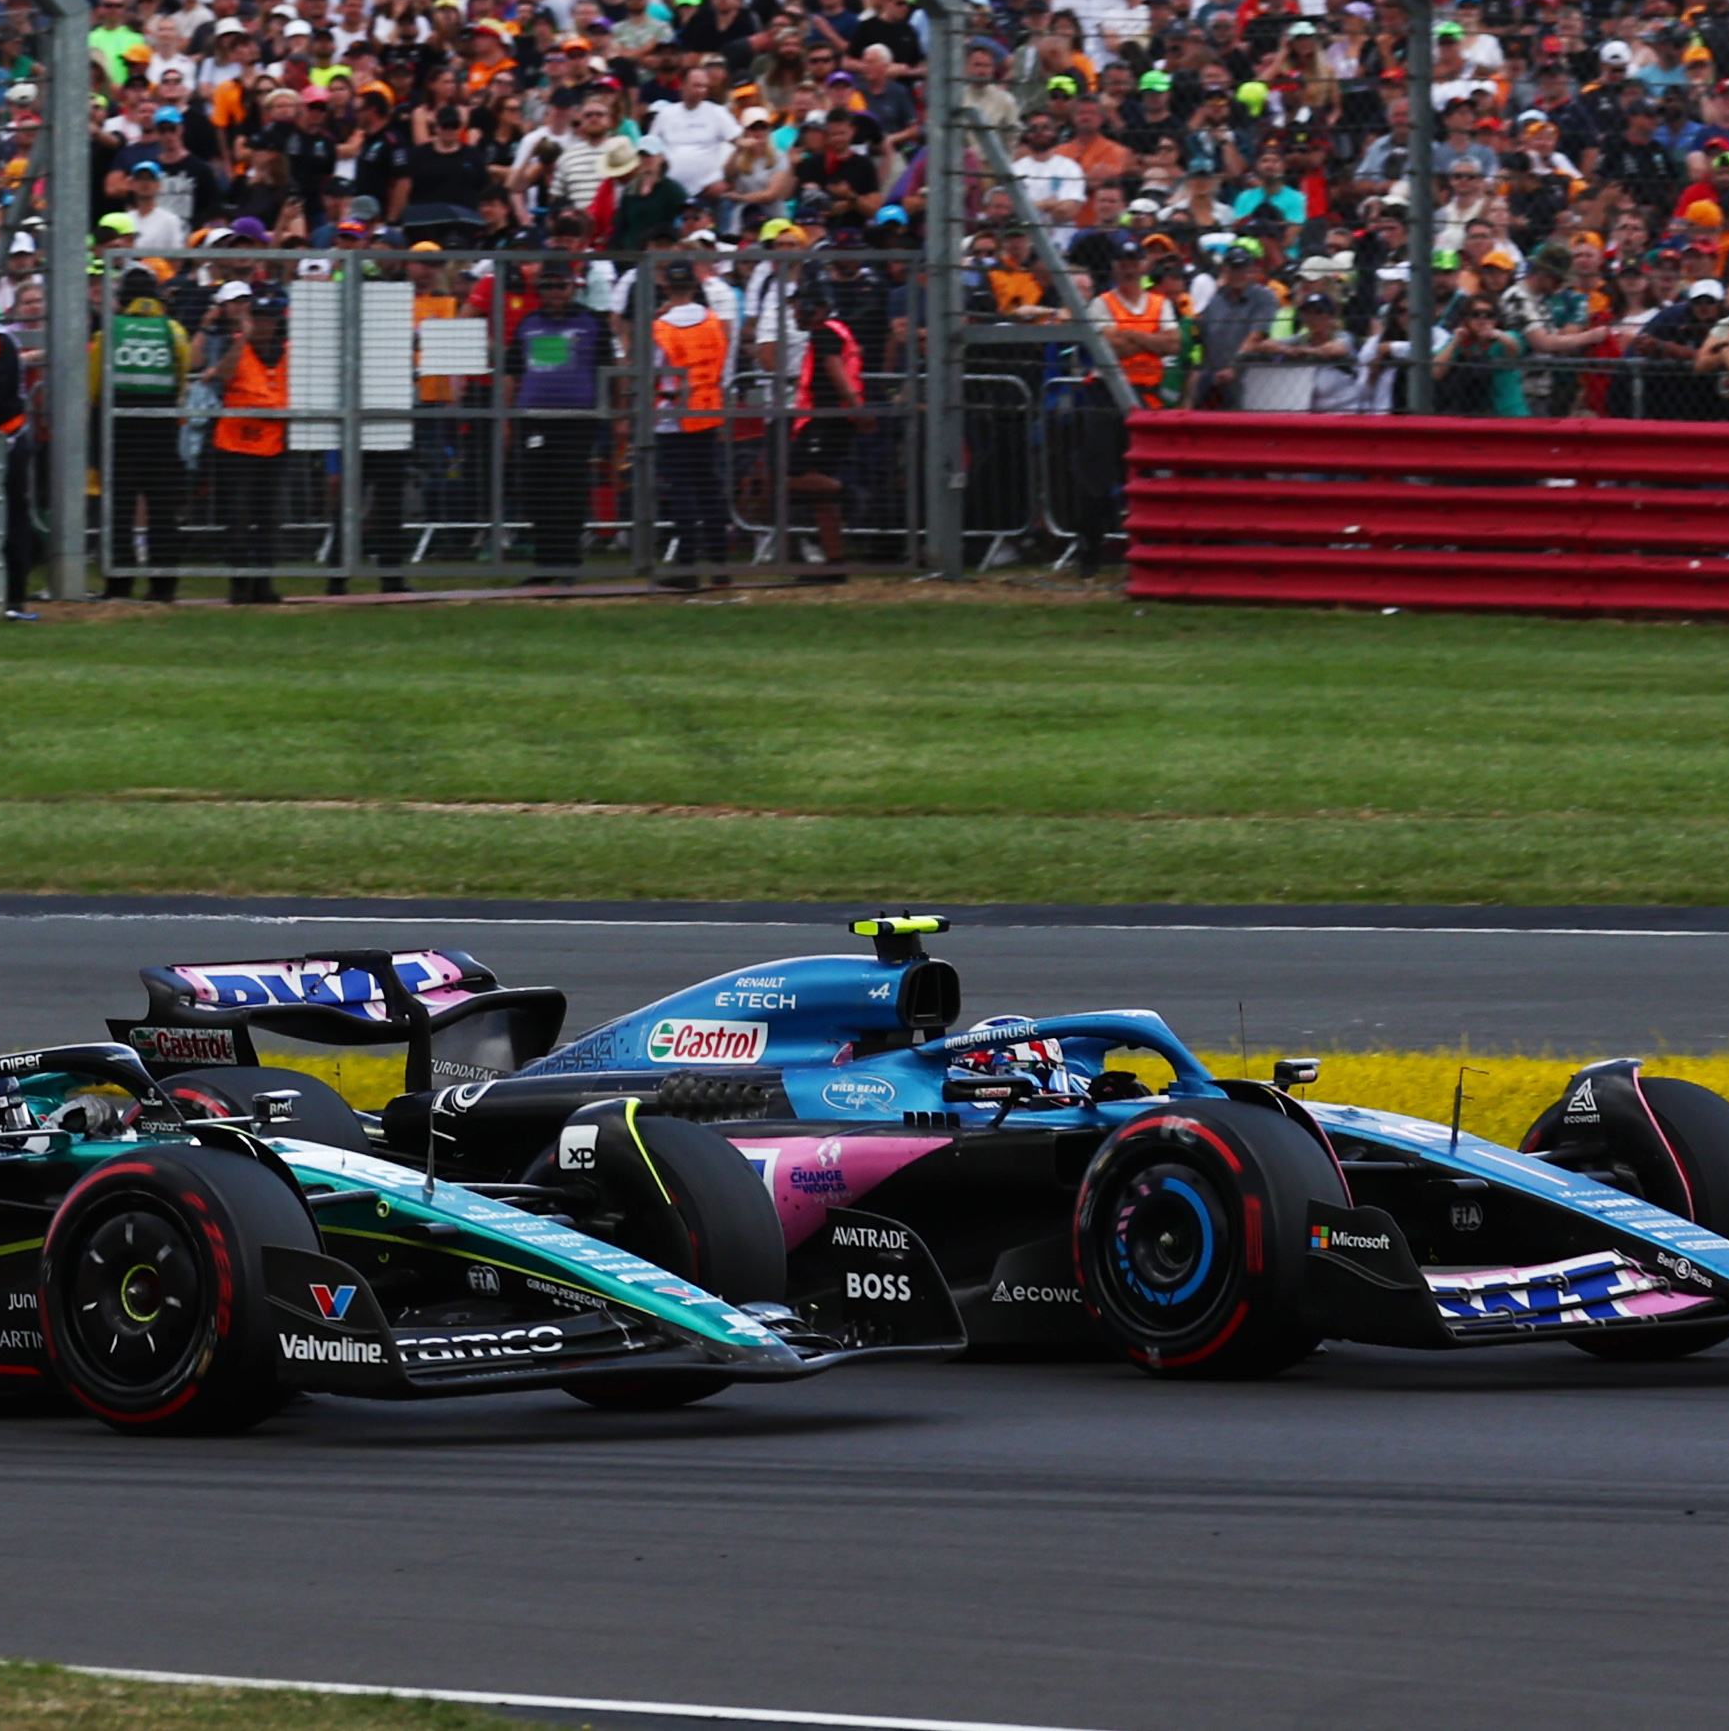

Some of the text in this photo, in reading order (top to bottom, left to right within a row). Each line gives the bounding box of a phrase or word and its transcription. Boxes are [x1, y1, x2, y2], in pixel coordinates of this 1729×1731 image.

[734, 977, 786, 988] RENAULT
[715, 991, 797, 1010] E-TECH
[673, 1024, 759, 1059] Castrol
[944, 1023, 1039, 1049] amazon music
[156, 1031, 234, 1061] Castrol
[831, 1082, 887, 1095] WILD BEAN
[1563, 1113, 1601, 1124] ecowatt
[790, 1170, 844, 1183] CHANGE
[802, 1182, 847, 1194] WORLD
[1451, 1208, 1481, 1225] FIA
[831, 1225, 910, 1250] AVATRADE
[1331, 1231, 1391, 1250] Microsoft
[1657, 1252, 1676, 1268] Bell
[1690, 1270, 1713, 1289] Ross
[846, 1272, 912, 1302] BOSS
[279, 1332, 381, 1363] Valvoline
